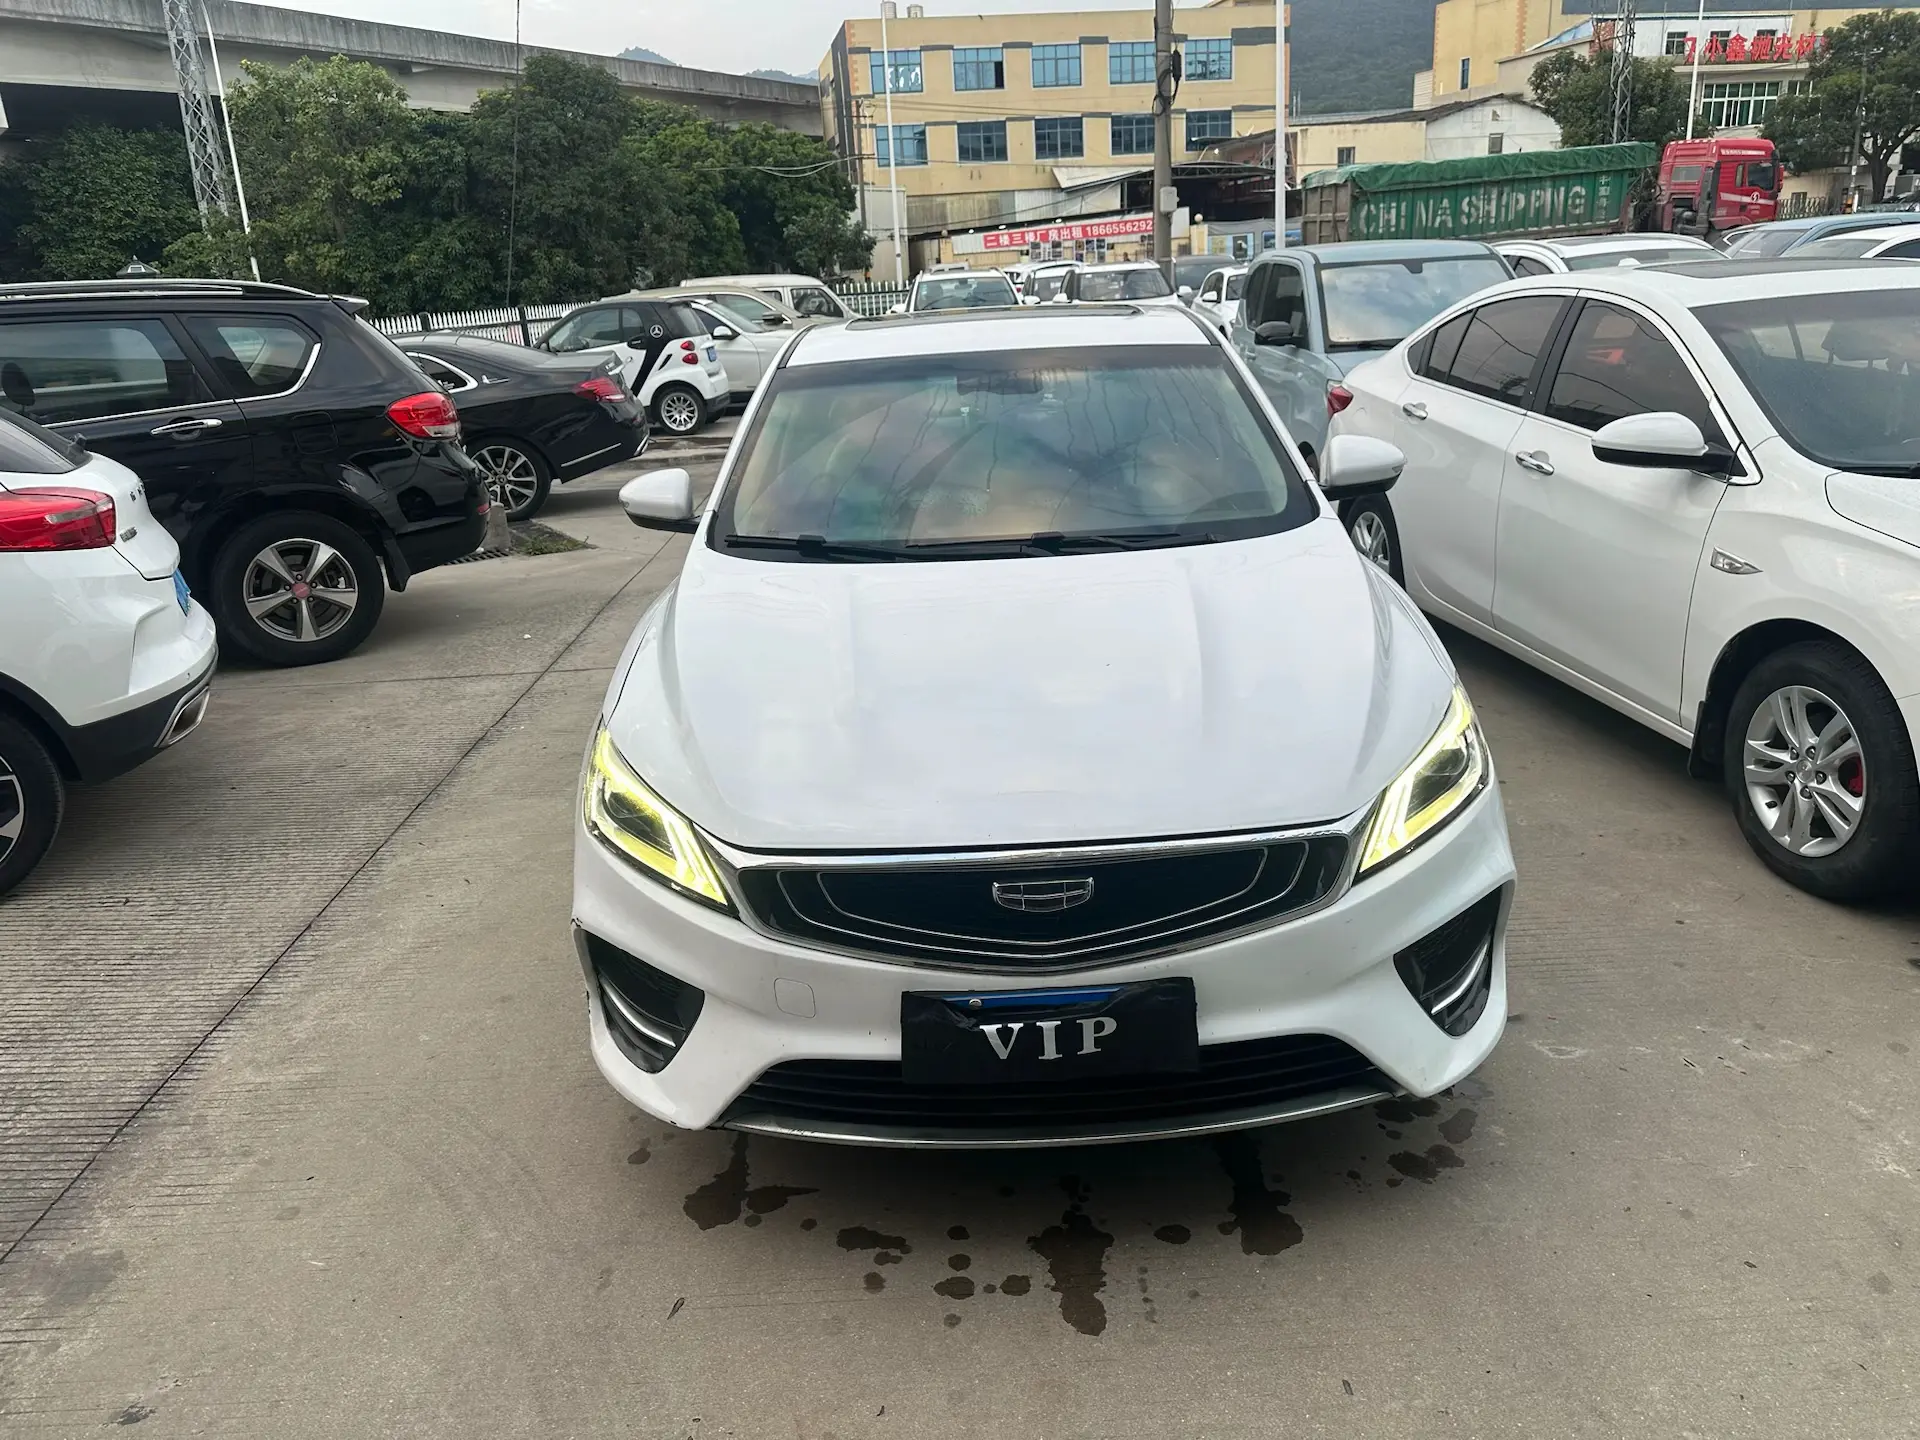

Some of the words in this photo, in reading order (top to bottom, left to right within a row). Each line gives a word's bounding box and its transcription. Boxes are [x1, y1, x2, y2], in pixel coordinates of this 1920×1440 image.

[1359, 198, 1452, 234] CHINA
[986, 226, 1082, 247] 二楼三楼厂房出租
[979, 1016, 1117, 1060] VIP
